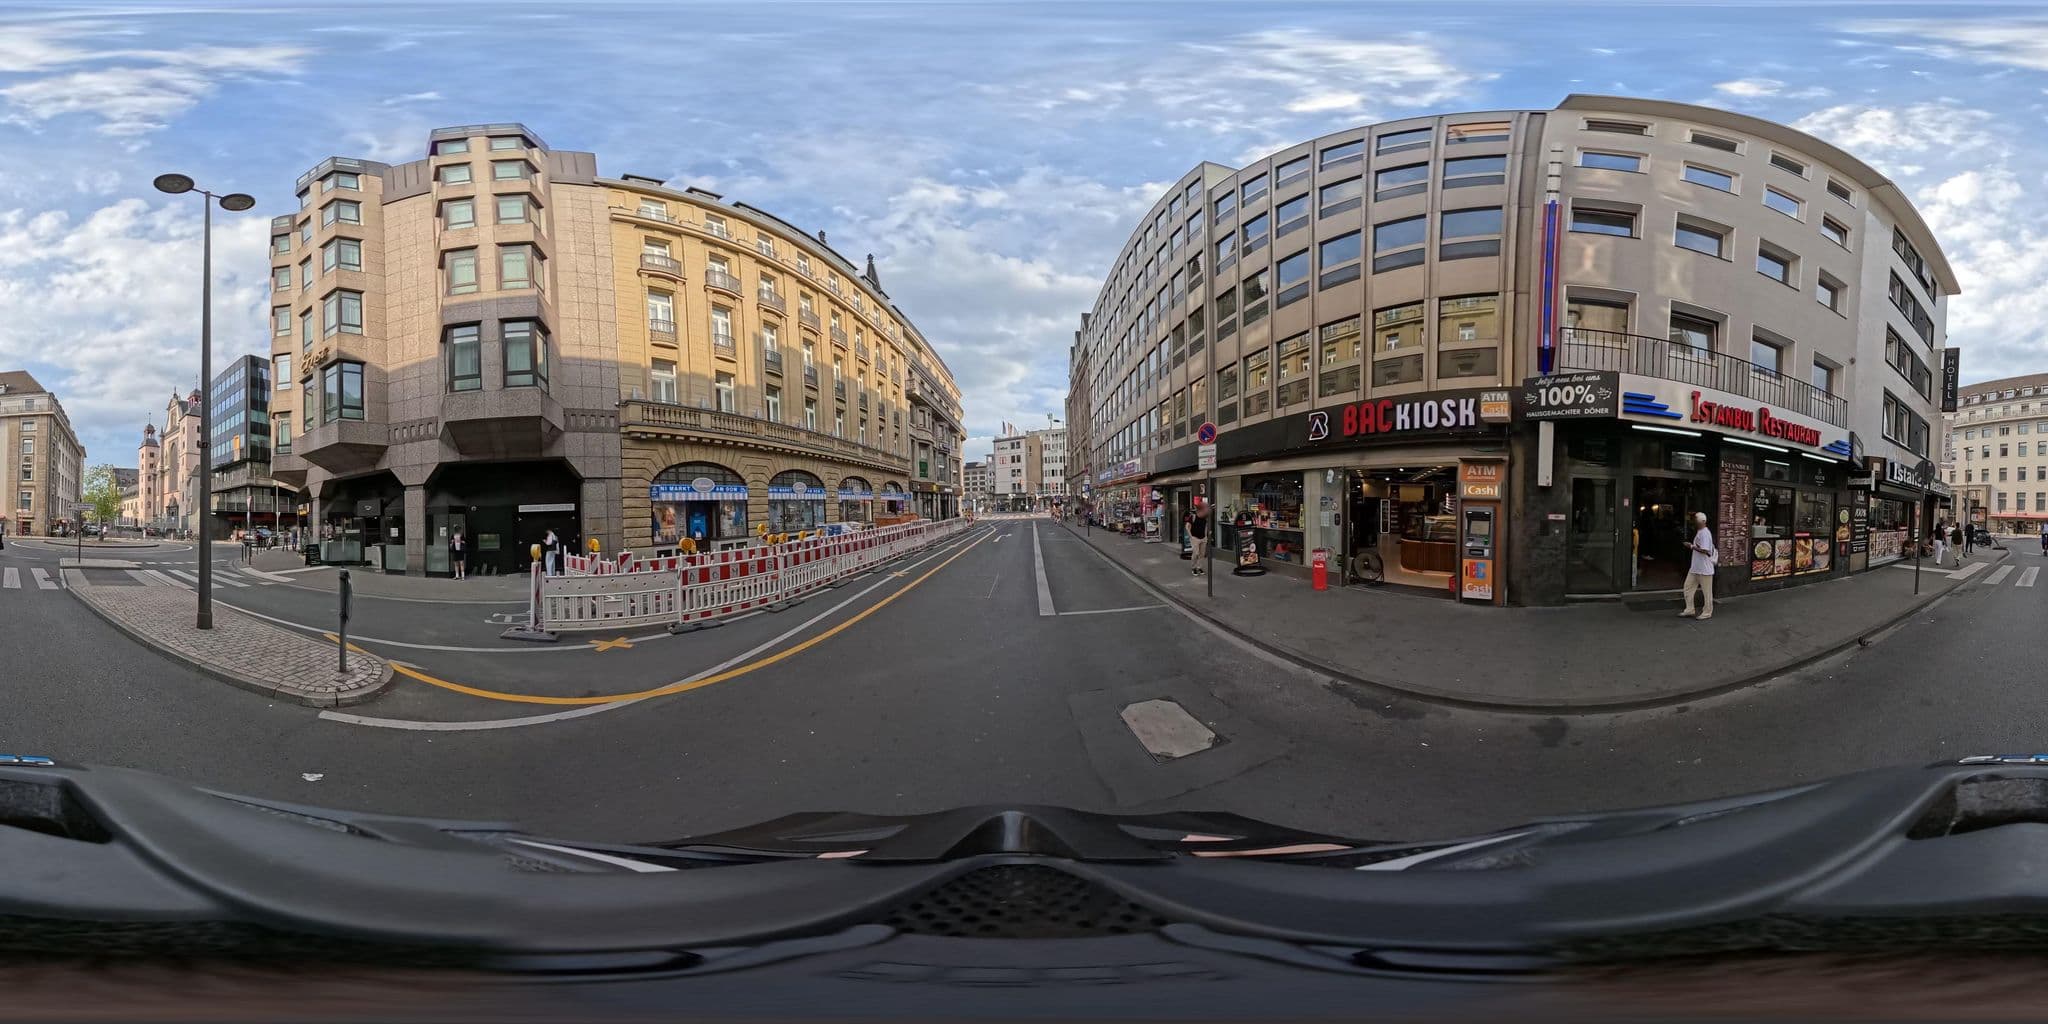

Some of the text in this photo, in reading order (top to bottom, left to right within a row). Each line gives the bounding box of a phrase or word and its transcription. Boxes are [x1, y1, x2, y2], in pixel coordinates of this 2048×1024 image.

[1571, 374, 1585, 383] bei
[1585, 374, 1601, 382] uns
[1947, 359, 1955, 399] HOTEL
[1481, 393, 1508, 402] ATM
[1539, 385, 1595, 407] 100%
[1526, 407, 1609, 418] HAUSGEMACHTER DÖNER
[1467, 465, 1496, 476] ATM
